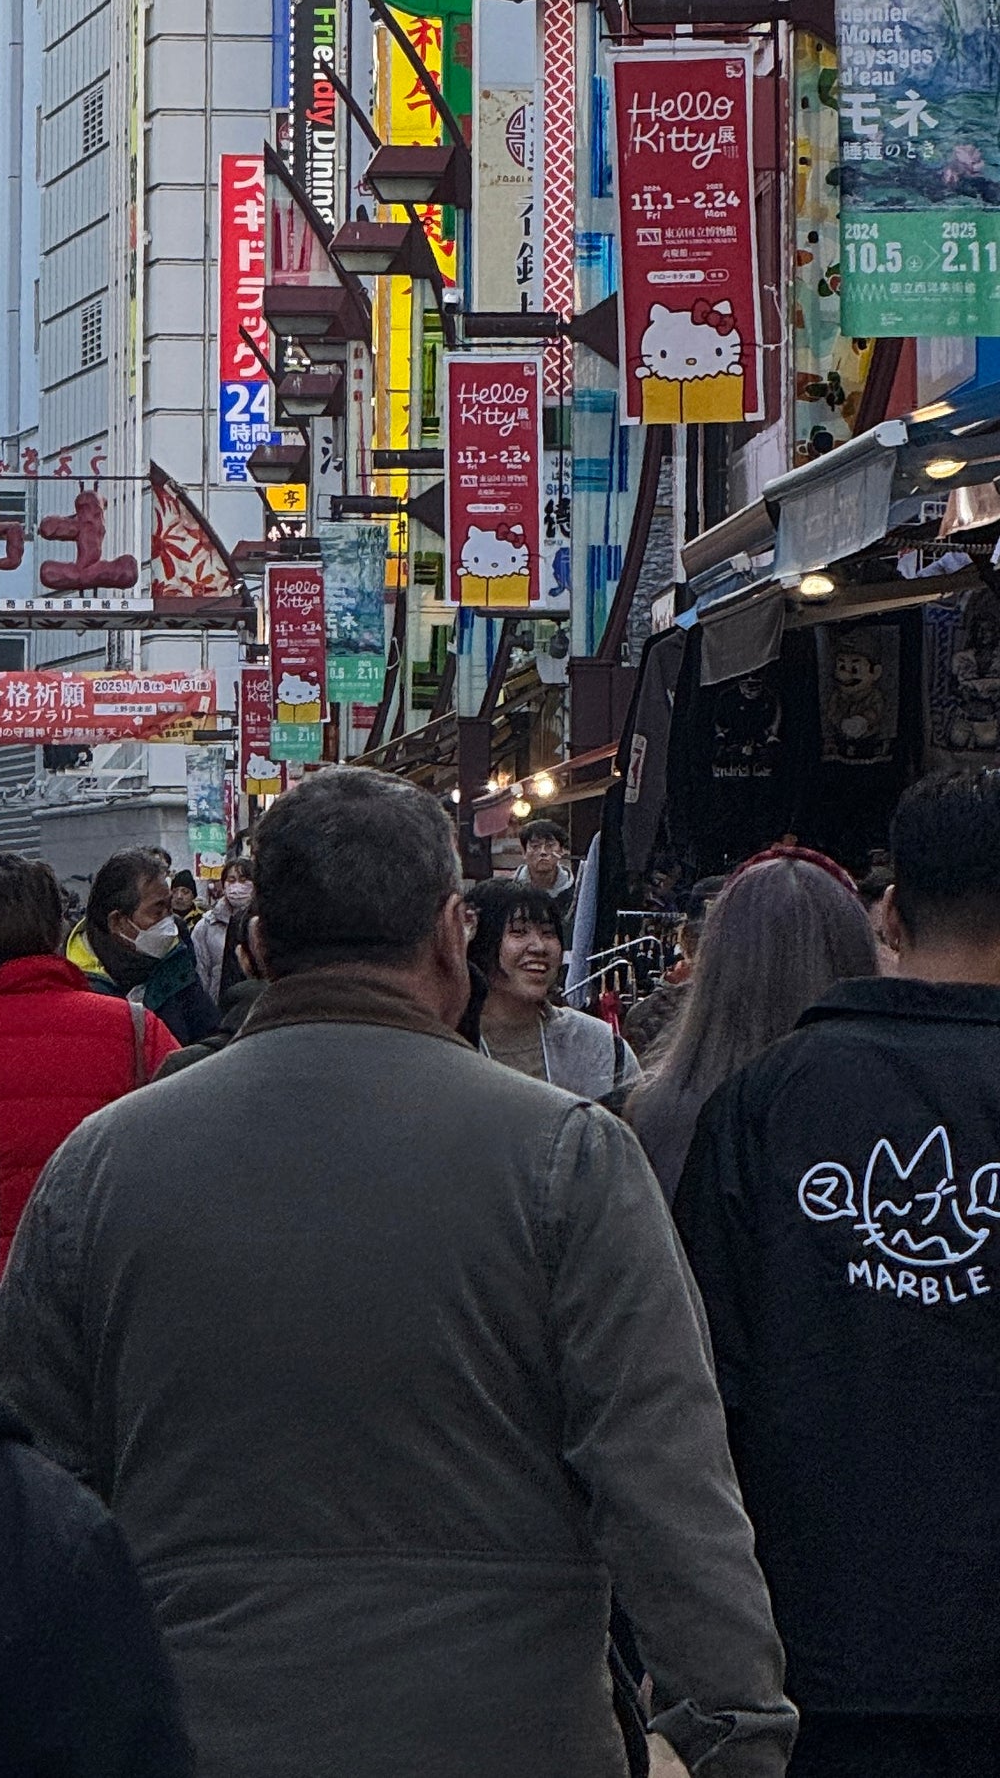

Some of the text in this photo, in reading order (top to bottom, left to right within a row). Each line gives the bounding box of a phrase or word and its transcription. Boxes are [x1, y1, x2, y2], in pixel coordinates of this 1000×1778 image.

[840, 5, 910, 22] dernier
[840, 23, 903, 44] Monet
[840, 44, 934, 69] Paysages
[627, 91, 735, 122] Hello
[840, 89, 940, 137] モネ
[633, 122, 722, 170] Kitty
[717, 125, 736, 144] 展
[842, 140, 936, 161] 睡蓮のとき
[631, 190, 741, 211] 11.1 2.24
[646, 209, 727, 220] Fri Mon
[844, 221, 977, 240] 2024 2025
[844, 241, 902, 273] 10.5
[941, 241, 998, 273] 2.11
[225, 384, 270, 423] 24
[457, 383, 530, 405] Hello
[460, 404, 520, 437] Kitty
[230, 423, 271, 443] 時間
[457, 450, 531, 464] 11.1 2.24
[223, 455, 248, 482] 営
[273, 580, 321, 596] Hello
[276, 594, 313, 615] Kitty
[329, 666, 379, 680] 0.5 2.11
[246, 680, 271, 691] Hel
[247, 691, 271, 702] Kitt
[848, 1259, 991, 1305] MARBLE
